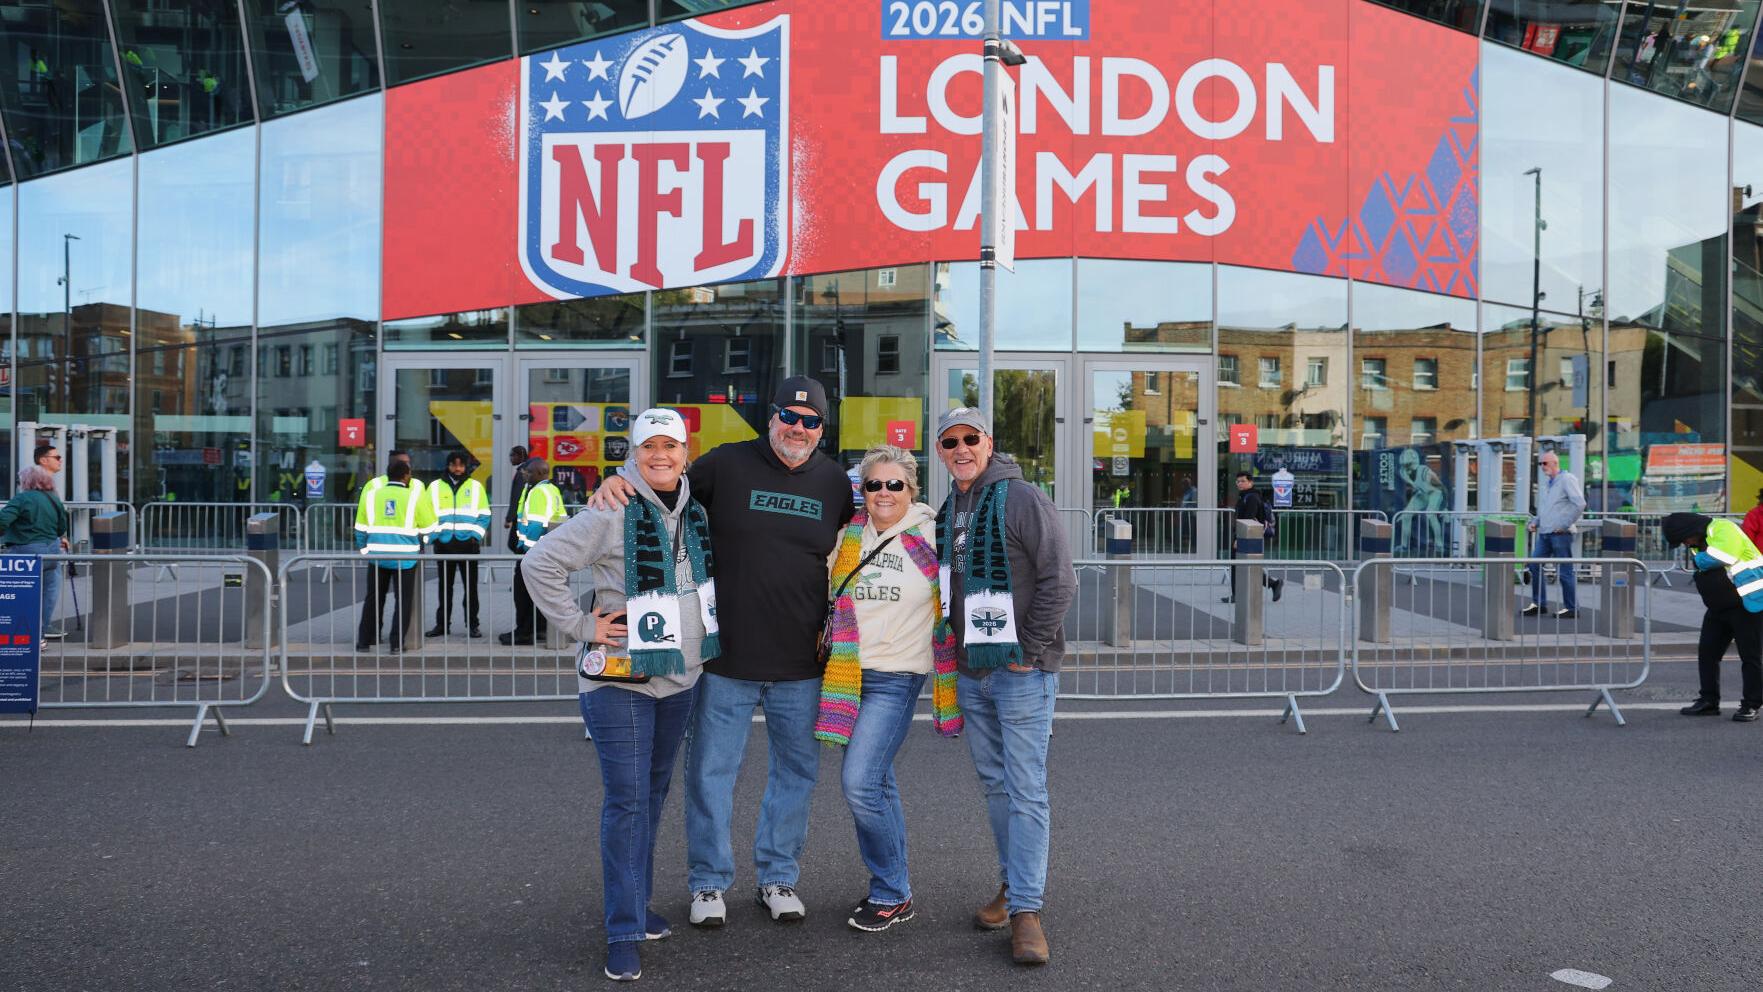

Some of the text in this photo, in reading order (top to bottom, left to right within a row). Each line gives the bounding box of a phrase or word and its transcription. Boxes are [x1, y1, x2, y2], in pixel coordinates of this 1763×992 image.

[890, 1, 1082, 36] 2026 NFL
[880, 53, 1335, 143] LONDON
[551, 142, 754, 290] NFL
[348, 432, 356, 440] 4
[897, 433, 904, 442] 3
[1240, 437, 1247, 446] 3
[754, 494, 820, 515] EAGLES
[646, 615, 659, 630] P
